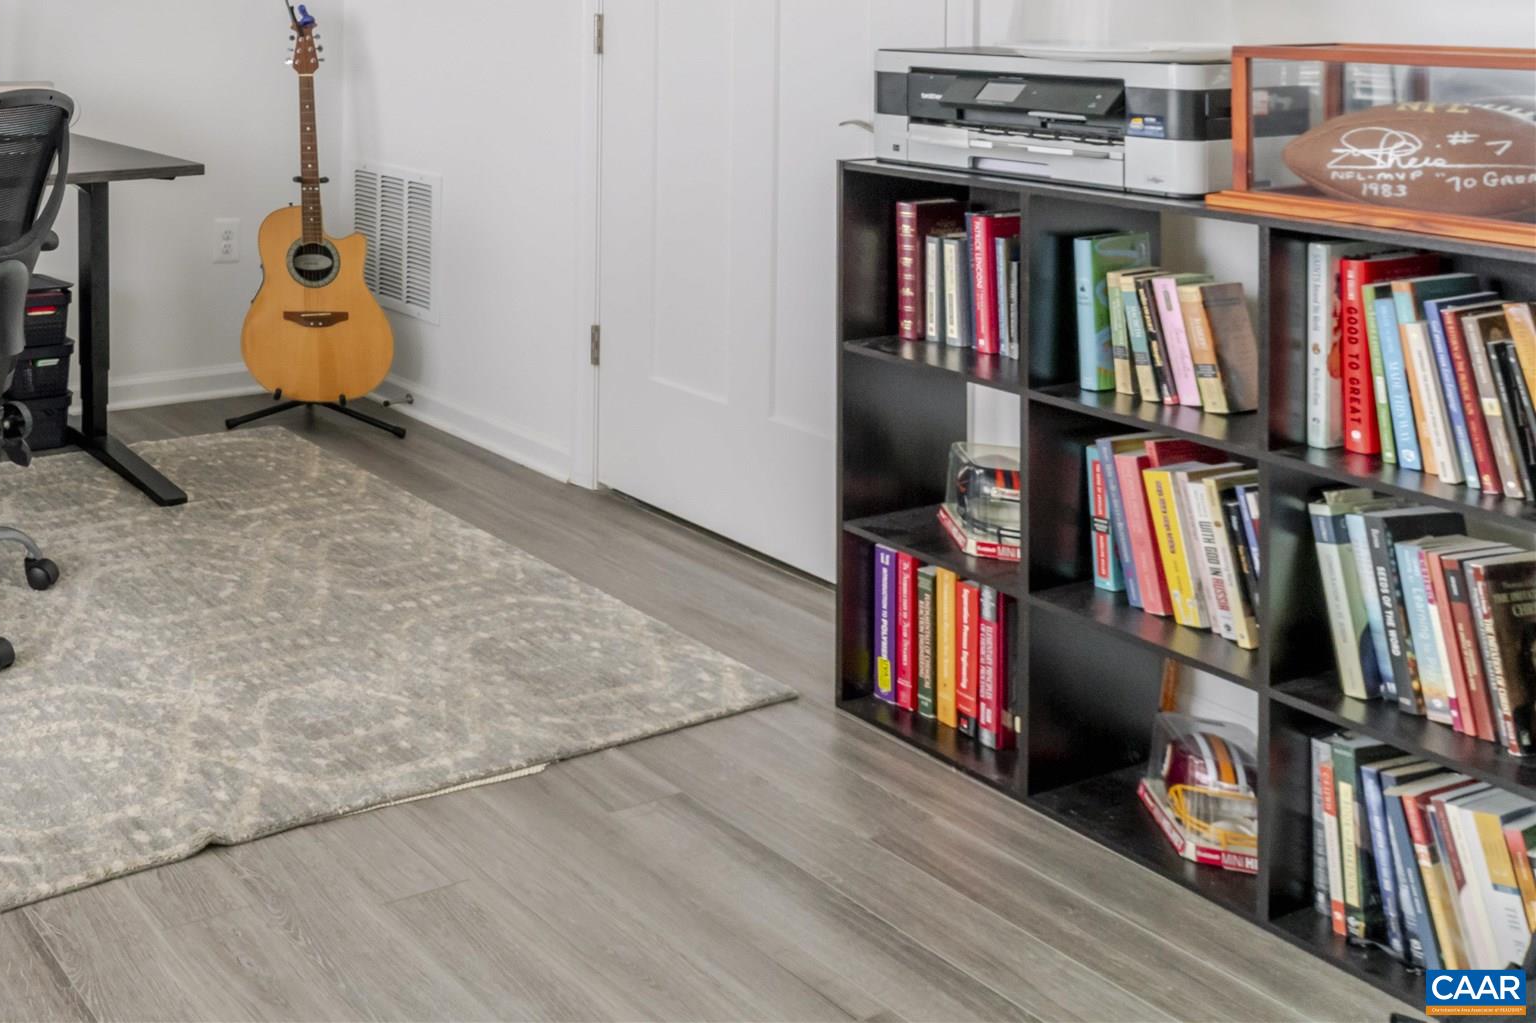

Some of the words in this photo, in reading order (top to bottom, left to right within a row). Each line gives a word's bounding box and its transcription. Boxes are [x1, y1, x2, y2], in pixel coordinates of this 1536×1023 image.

[1360, 183, 1408, 197] 1983
[971, 221, 983, 251] PATRICK
[973, 252, 985, 289] LENCIONI
[1312, 254, 1320, 281] SAINTS
[1346, 305, 1359, 345] GOOD
[1347, 352, 1360, 371] TO
[1387, 360, 1402, 393] MADE
[1348, 376, 1361, 425] GREAT
[1392, 391, 1407, 420] THIS
[1396, 418, 1411, 444] WAY
[1197, 517, 1215, 546] WITH
[1203, 542, 1220, 567] GOD
[1207, 563, 1222, 578] IN
[1375, 563, 1390, 594] SEEDS
[880, 566, 888, 610] INTRODUCTION
[1210, 574, 1230, 614] RUSSIA
[1380, 593, 1392, 610] OF
[1383, 607, 1396, 630] THE
[1410, 583, 1433, 641] Learning
[1483, 616, 1495, 635] THE
[1387, 626, 1401, 659] WORD
[1487, 633, 1503, 677] IMITATION
[960, 648, 968, 690] Engineering
[1497, 686, 1511, 717] CHRIST
[1221, 852, 1246, 865] MINI
